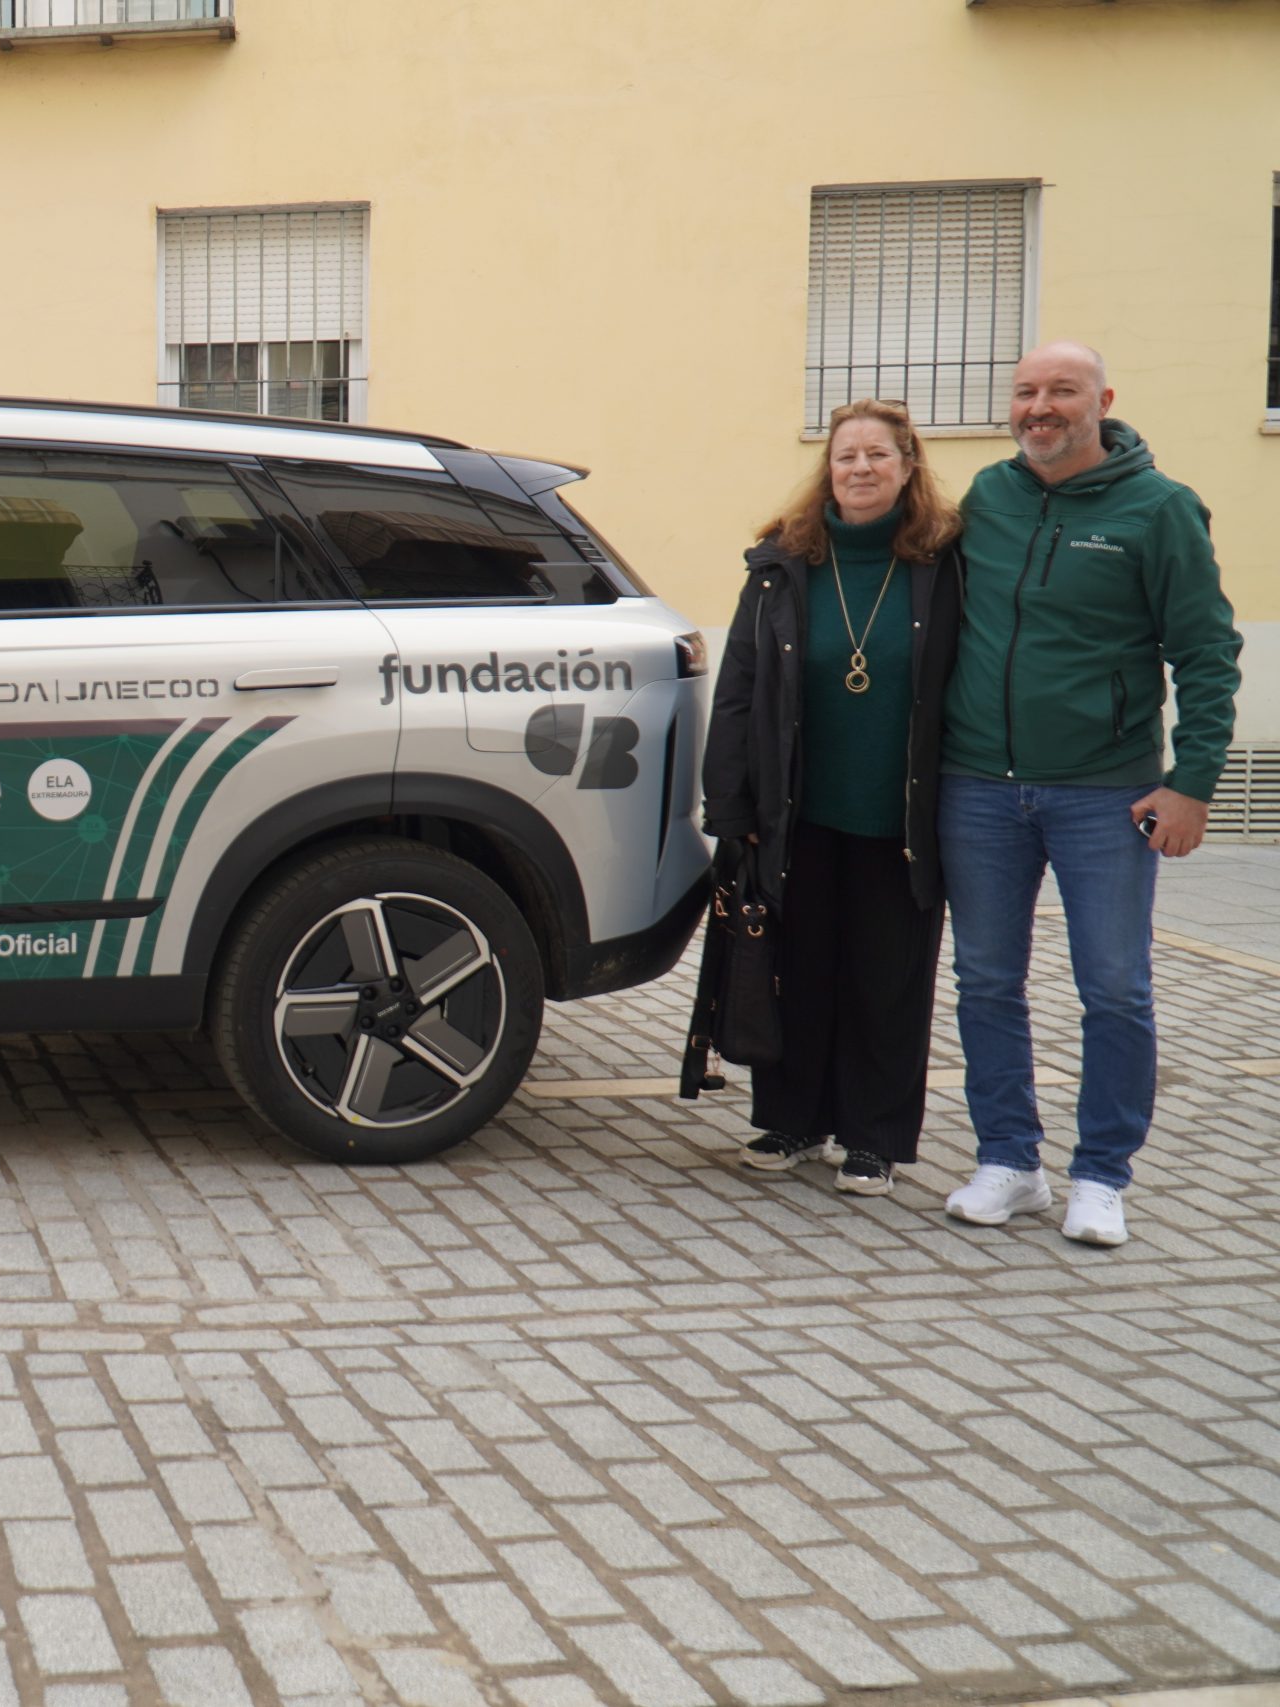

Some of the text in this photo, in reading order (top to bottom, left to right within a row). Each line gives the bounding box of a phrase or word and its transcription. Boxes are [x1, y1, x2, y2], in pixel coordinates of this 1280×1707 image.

[1090, 534, 1106, 542] ELA
[1070, 540, 1124, 552] EXTREMADURA
[378, 647, 633, 706] fundación
[64, 679, 220, 701] JAECOO
[46, 775, 74, 788] ELA
[31, 790, 89, 799] EXTREMADURA
